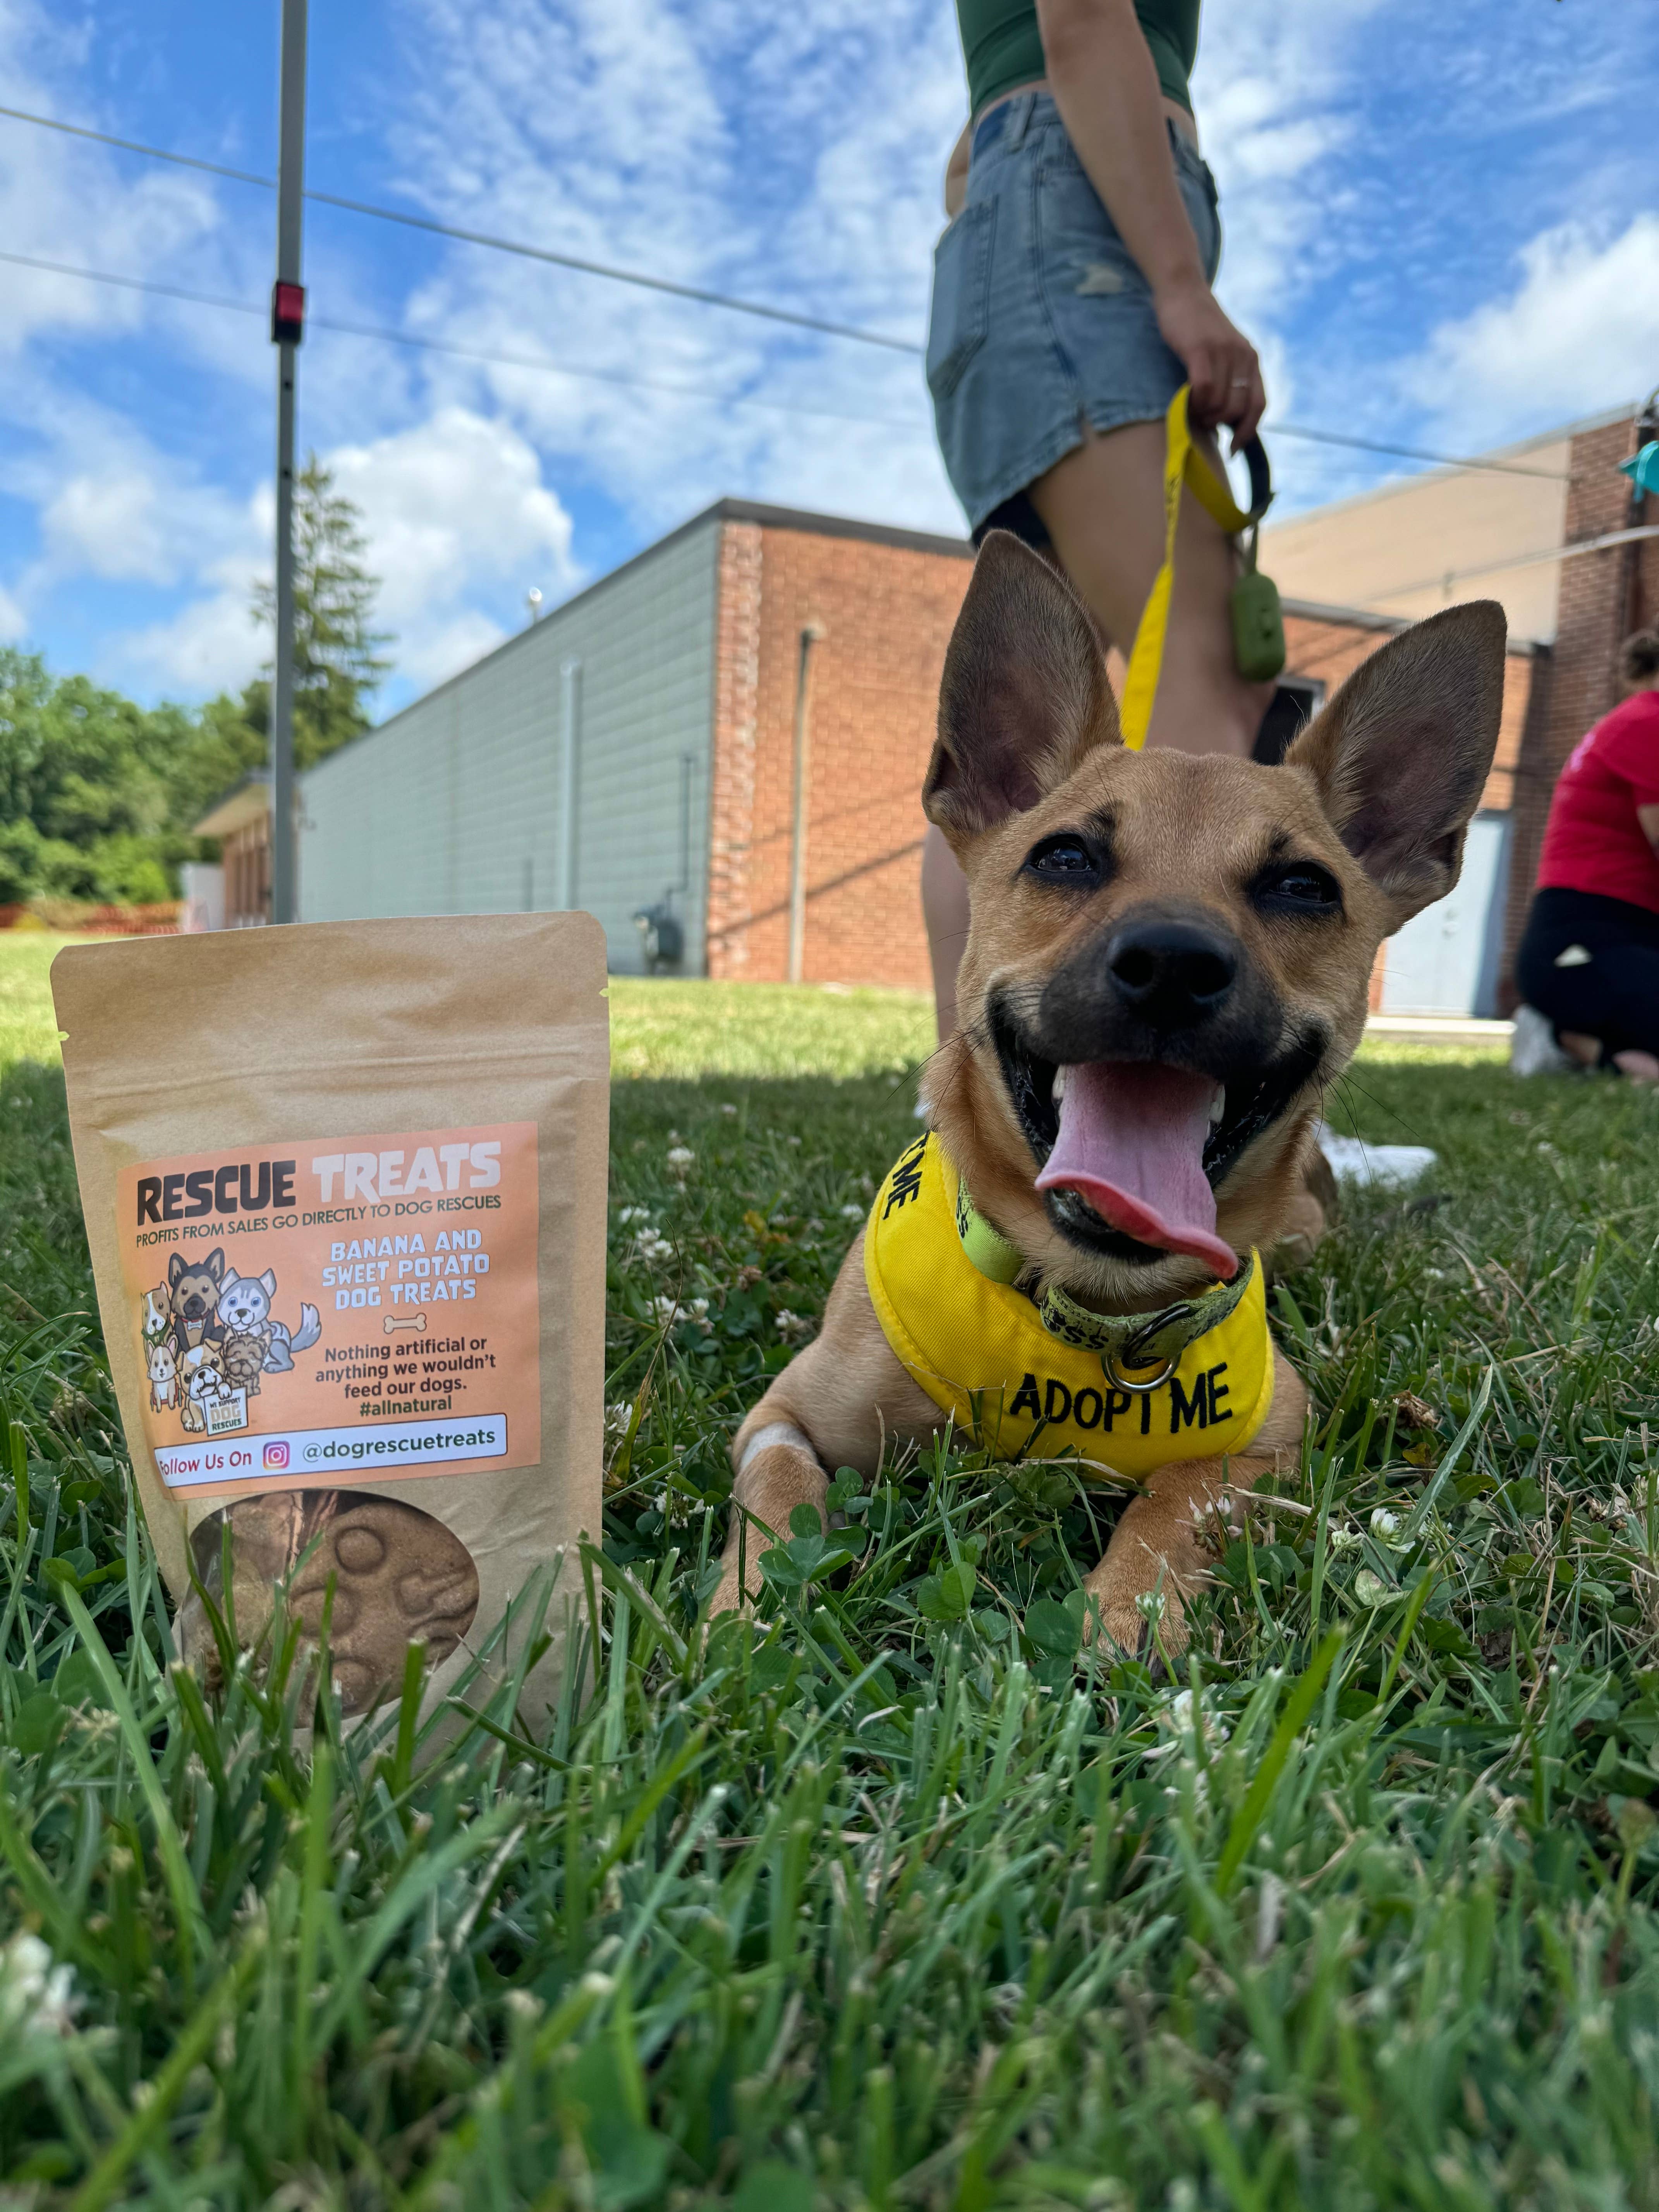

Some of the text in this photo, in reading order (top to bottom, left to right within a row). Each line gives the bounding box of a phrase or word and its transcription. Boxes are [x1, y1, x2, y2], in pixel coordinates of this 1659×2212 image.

[137, 1141, 501, 1226] RESCUE TREATS
[882, 1148, 925, 1220] ME
[136, 1195, 501, 1248] PROFITS FROM SALES GO DIRECTLY TO DOG RESCUES
[331, 1229, 482, 1262] BANANA AND
[322, 1253, 490, 1287] SWEET POTATO
[336, 1279, 476, 1310] DOG TREATS
[325, 1336, 487, 1362] Nothing artificial or
[316, 1364, 388, 1383] anything
[393, 1362, 417, 1375] we
[345, 1377, 467, 1399] feed our dogs.
[218, 1397, 241, 1407] SUPPORT
[360, 1395, 452, 1417] #allnatural
[1170, 1362, 1233, 1433] ME
[210, 1404, 241, 1423] DOG
[212, 1418, 242, 1431] RESCUES
[205, 1453, 224, 1470] Us
[229, 1451, 252, 1467] On
[303, 1429, 496, 1463] @dogrescuetreats
